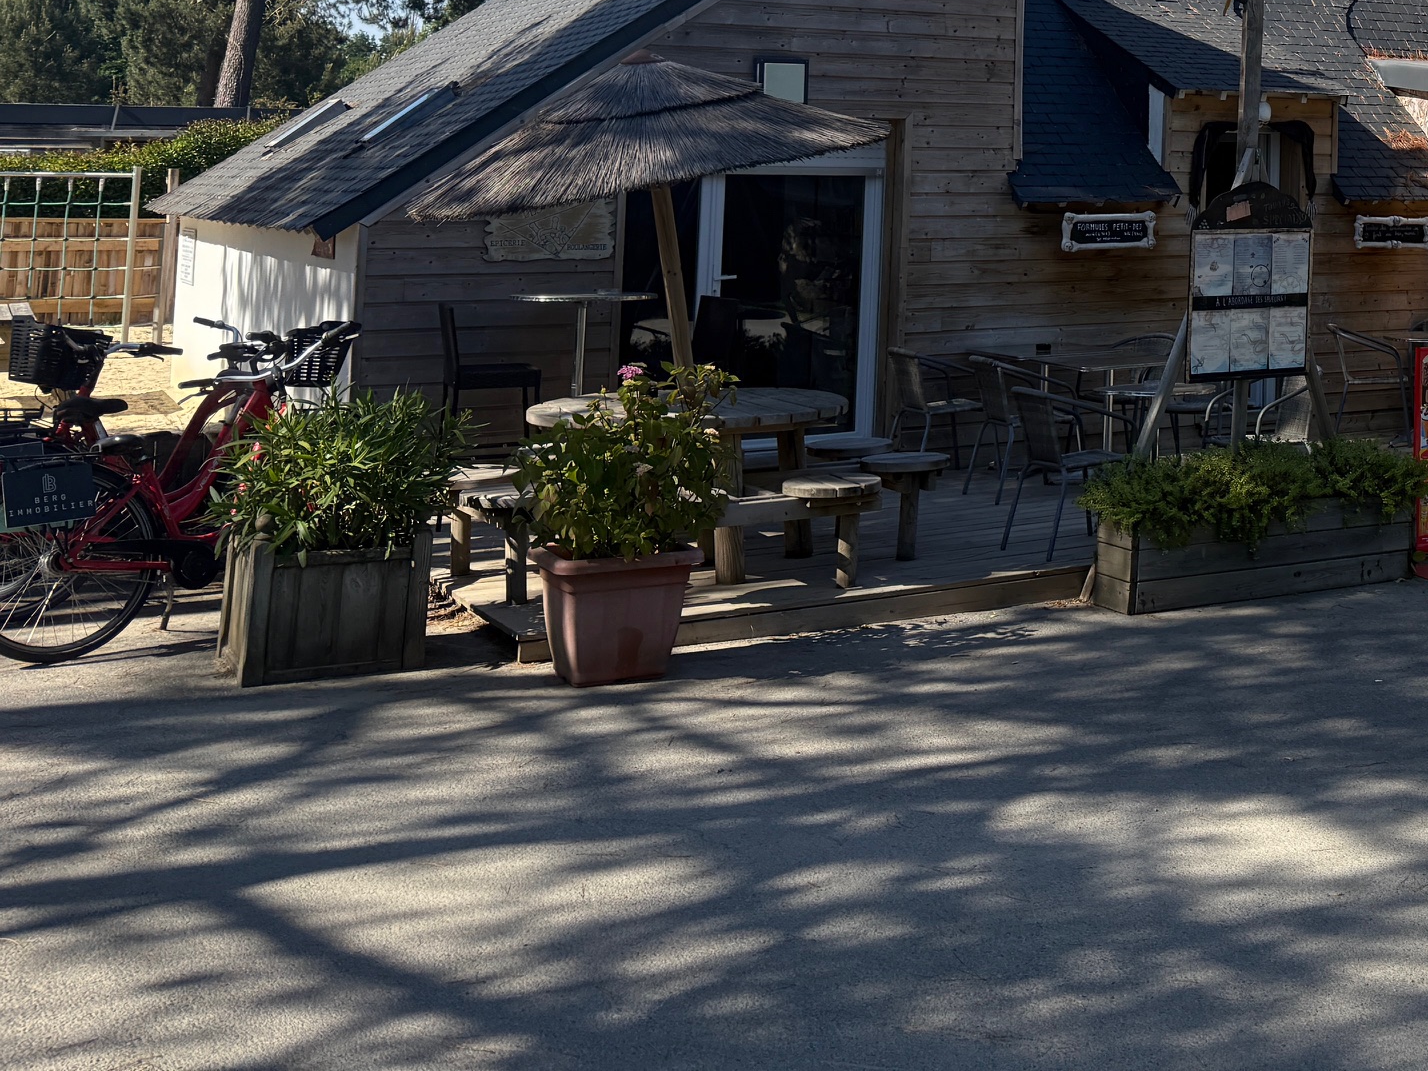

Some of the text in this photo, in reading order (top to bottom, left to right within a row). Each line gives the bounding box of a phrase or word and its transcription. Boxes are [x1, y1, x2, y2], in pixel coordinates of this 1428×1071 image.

[490, 239, 526, 247] EPICERIE
[566, 243, 607, 251] BOULANGERIE
[34, 493, 67, 504] BERG
[8, 500, 93, 517] IMMOBILIER
